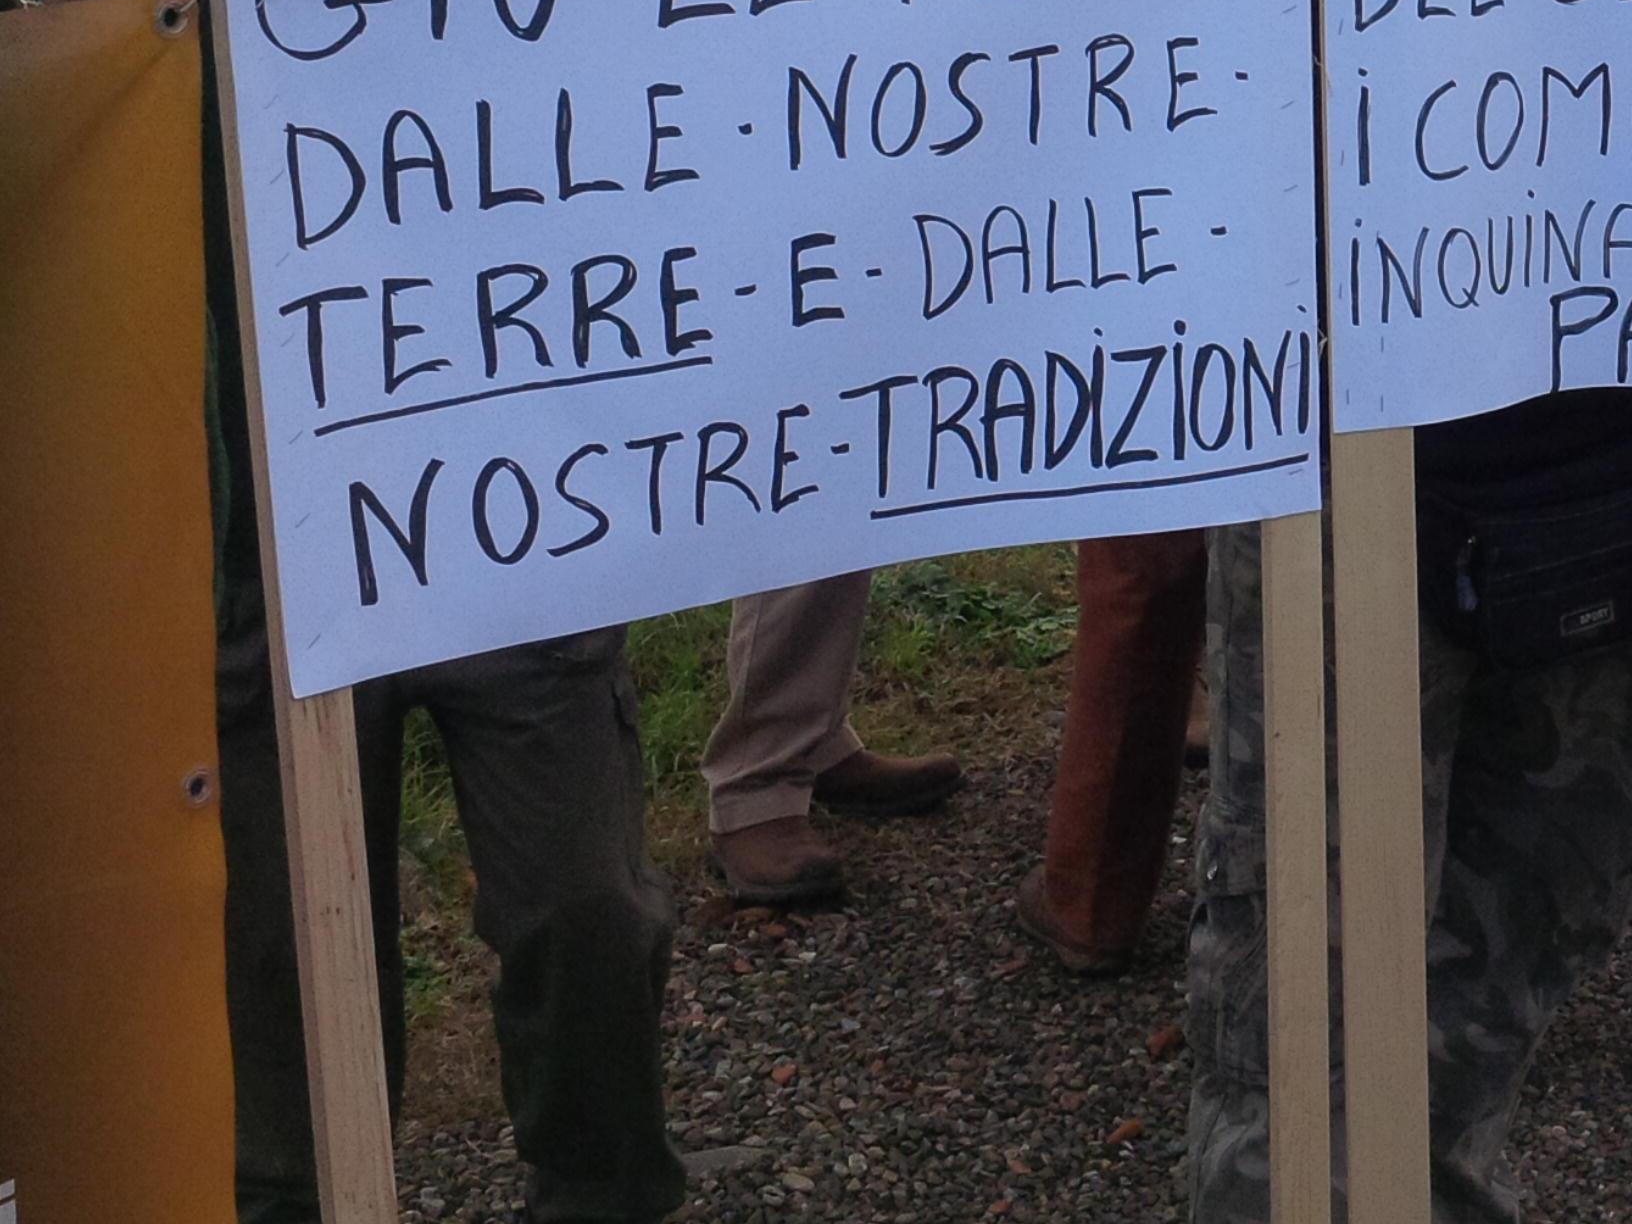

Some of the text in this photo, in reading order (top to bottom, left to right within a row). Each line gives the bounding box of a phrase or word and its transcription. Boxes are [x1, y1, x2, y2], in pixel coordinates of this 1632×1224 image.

[285, 84, 700, 250] DALLE
[1357, 67, 1370, 186] I
[279, 246, 713, 408] TERRE
